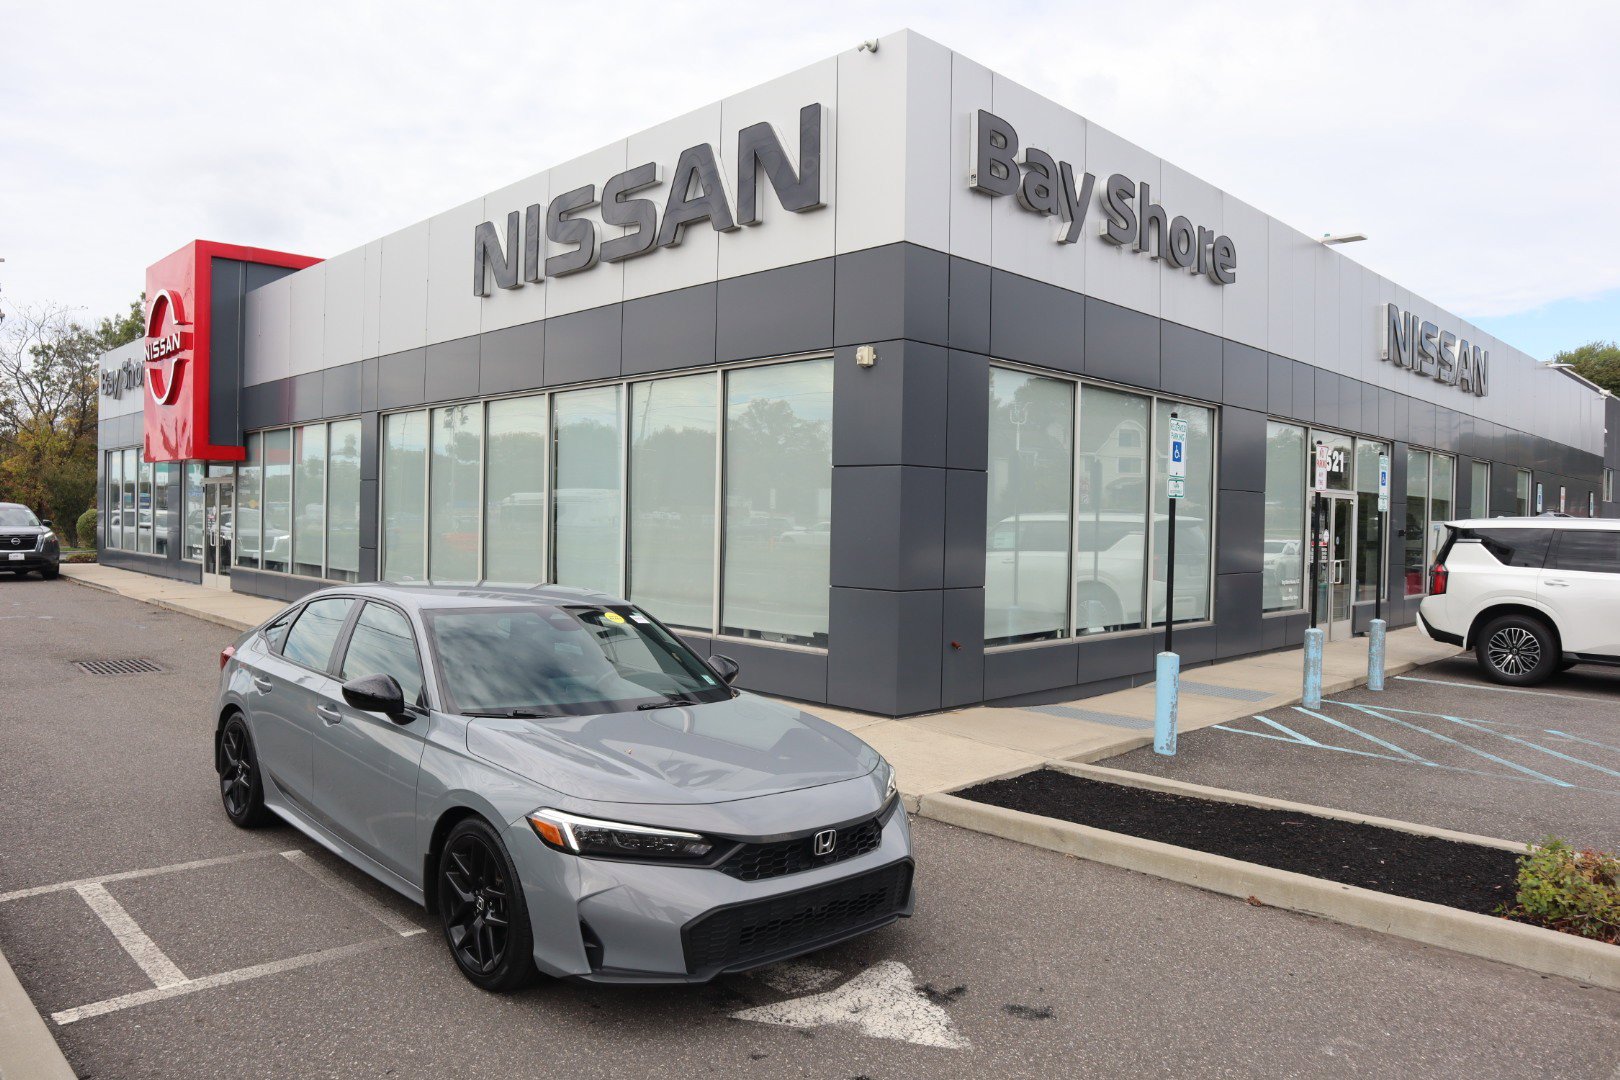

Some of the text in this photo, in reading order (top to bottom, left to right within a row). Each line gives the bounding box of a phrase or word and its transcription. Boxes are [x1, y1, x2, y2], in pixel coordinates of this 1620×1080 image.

[474, 102, 827, 297] NISSAN
[970, 109, 1237, 285] Bay Shore
[101, 368, 122, 400] Bay
[144, 332, 180, 361] NISSAN
[1382, 303, 1489, 397] NISSAN
